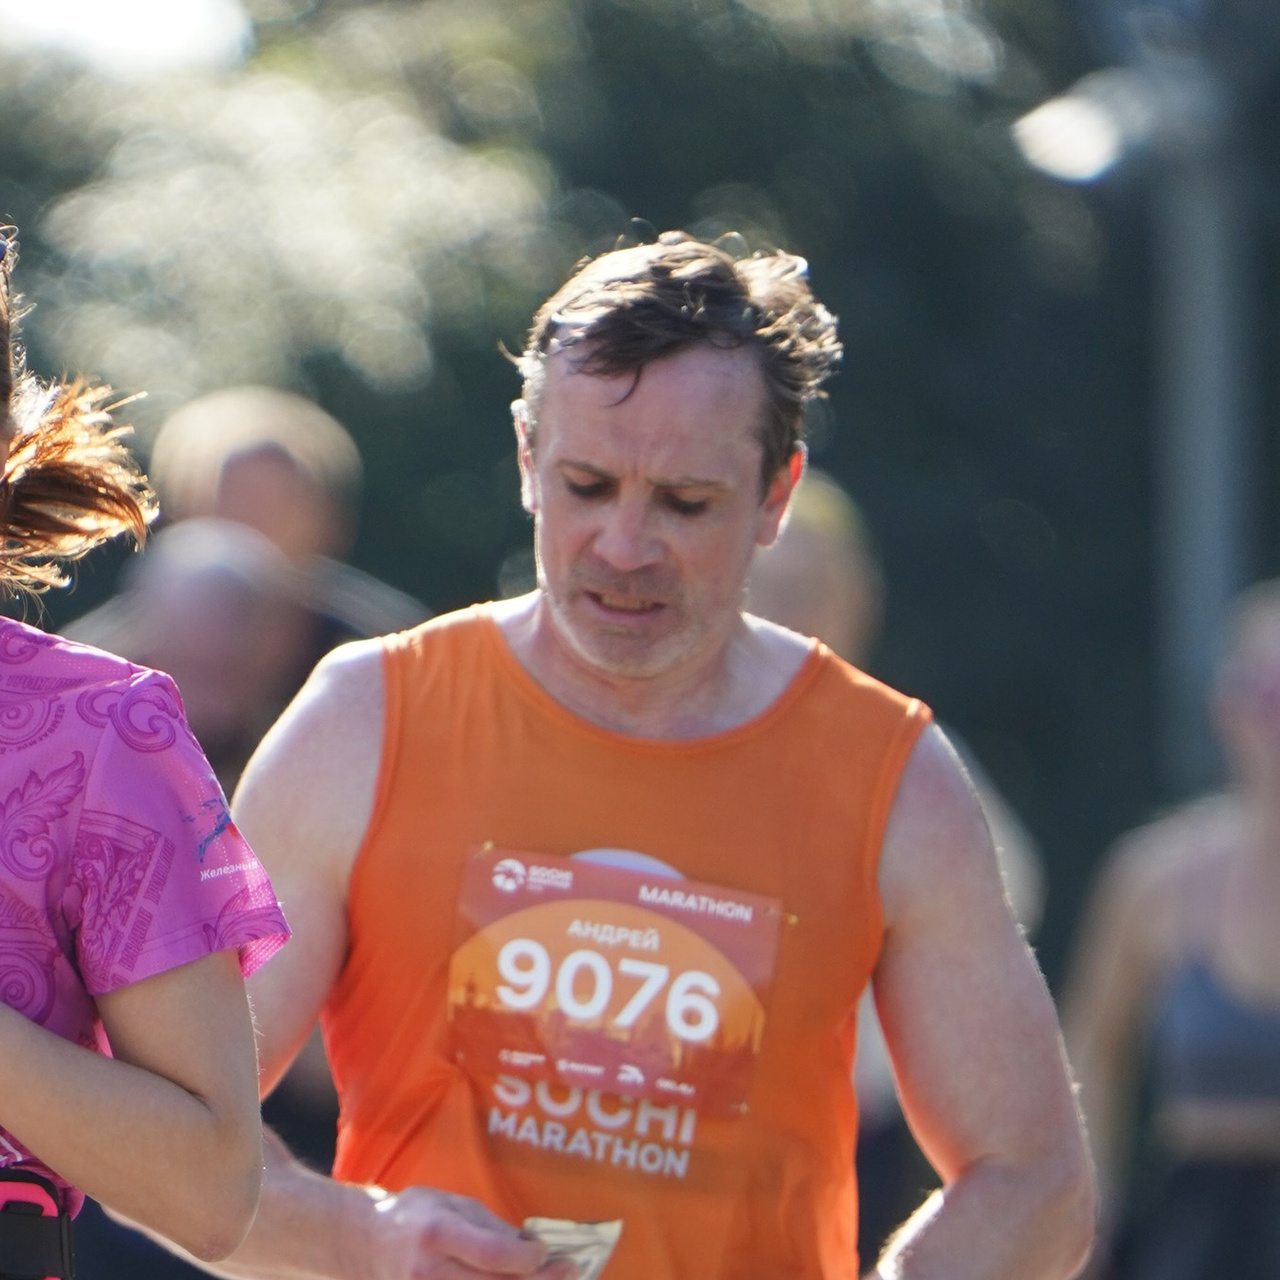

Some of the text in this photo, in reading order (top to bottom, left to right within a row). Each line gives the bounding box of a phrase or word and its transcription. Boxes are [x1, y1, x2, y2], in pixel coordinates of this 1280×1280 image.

[638, 884, 754, 923] MARATHON
[567, 919, 660, 951] АНДРЕЙ
[496, 938, 721, 1043] 9076
[488, 1106, 691, 1178] MARATHON
